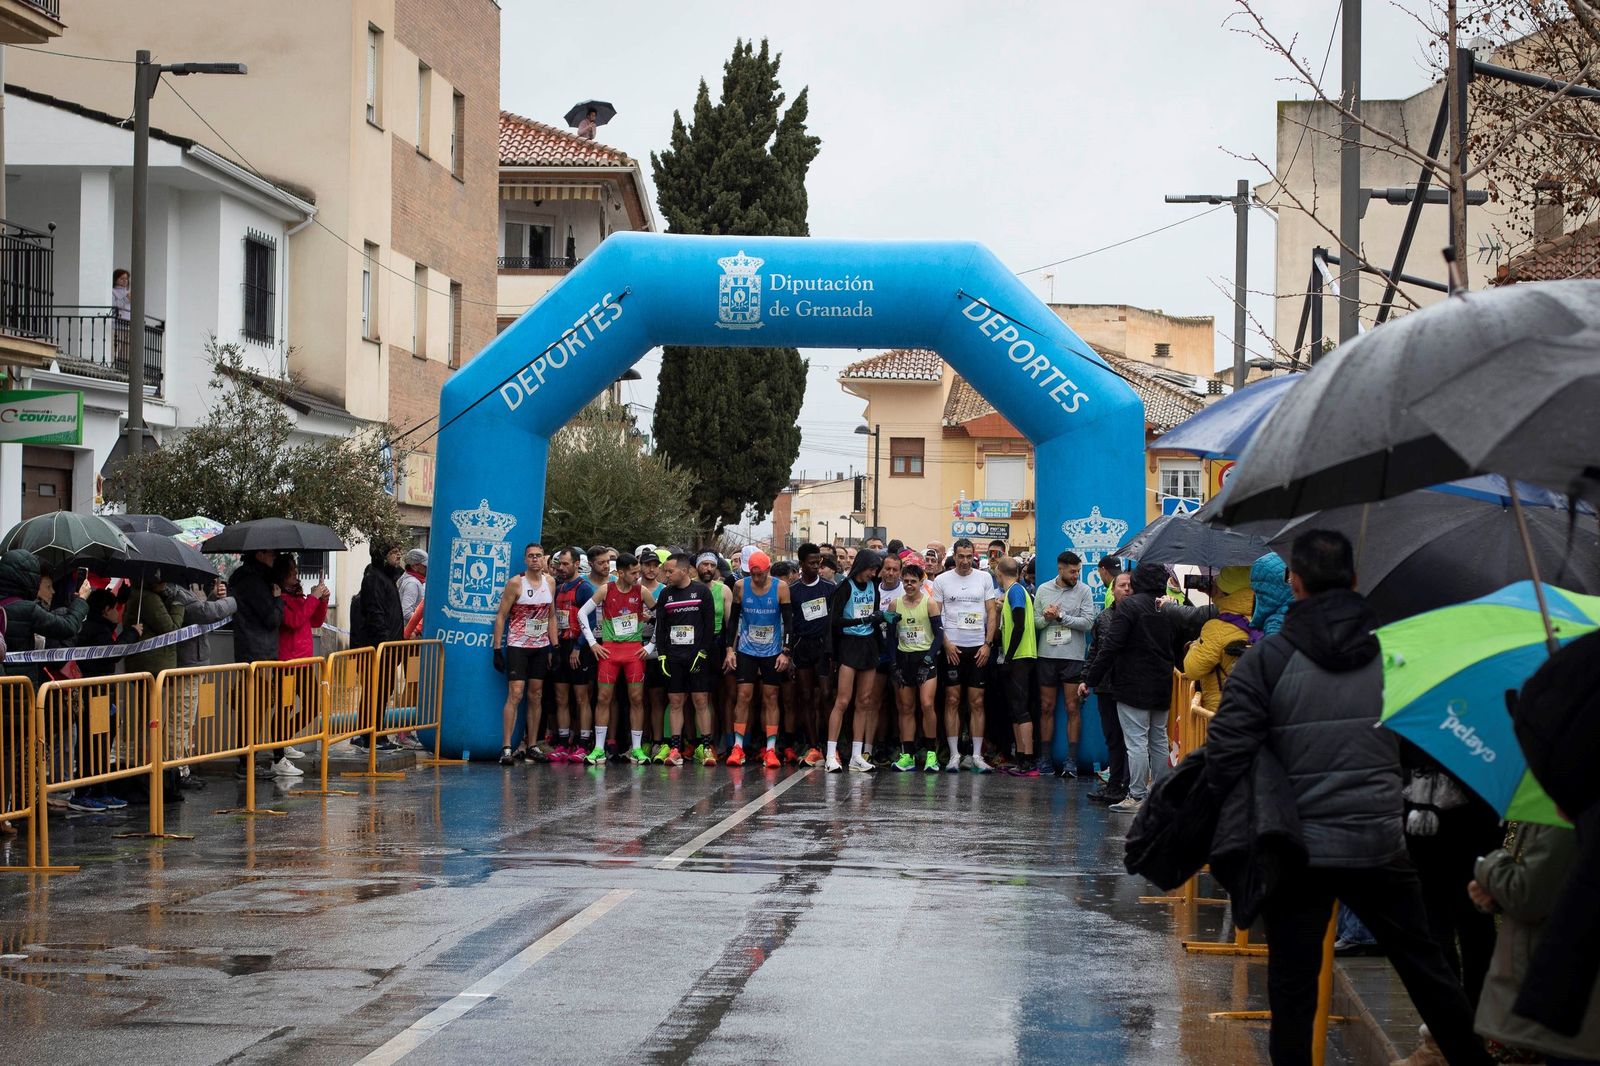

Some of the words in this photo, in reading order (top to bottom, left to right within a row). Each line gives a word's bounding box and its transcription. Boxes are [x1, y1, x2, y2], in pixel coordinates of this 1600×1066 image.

[769, 273, 874, 295] Diputación
[769, 300, 790, 317] de
[796, 300, 874, 317] Granada
[499, 292, 623, 412] DEPORTES
[961, 297, 1090, 413] DEPORTES
[810, 604, 821, 613] 190
[621, 620, 631, 628] 123
[1439, 715, 1496, 762] pelayo
